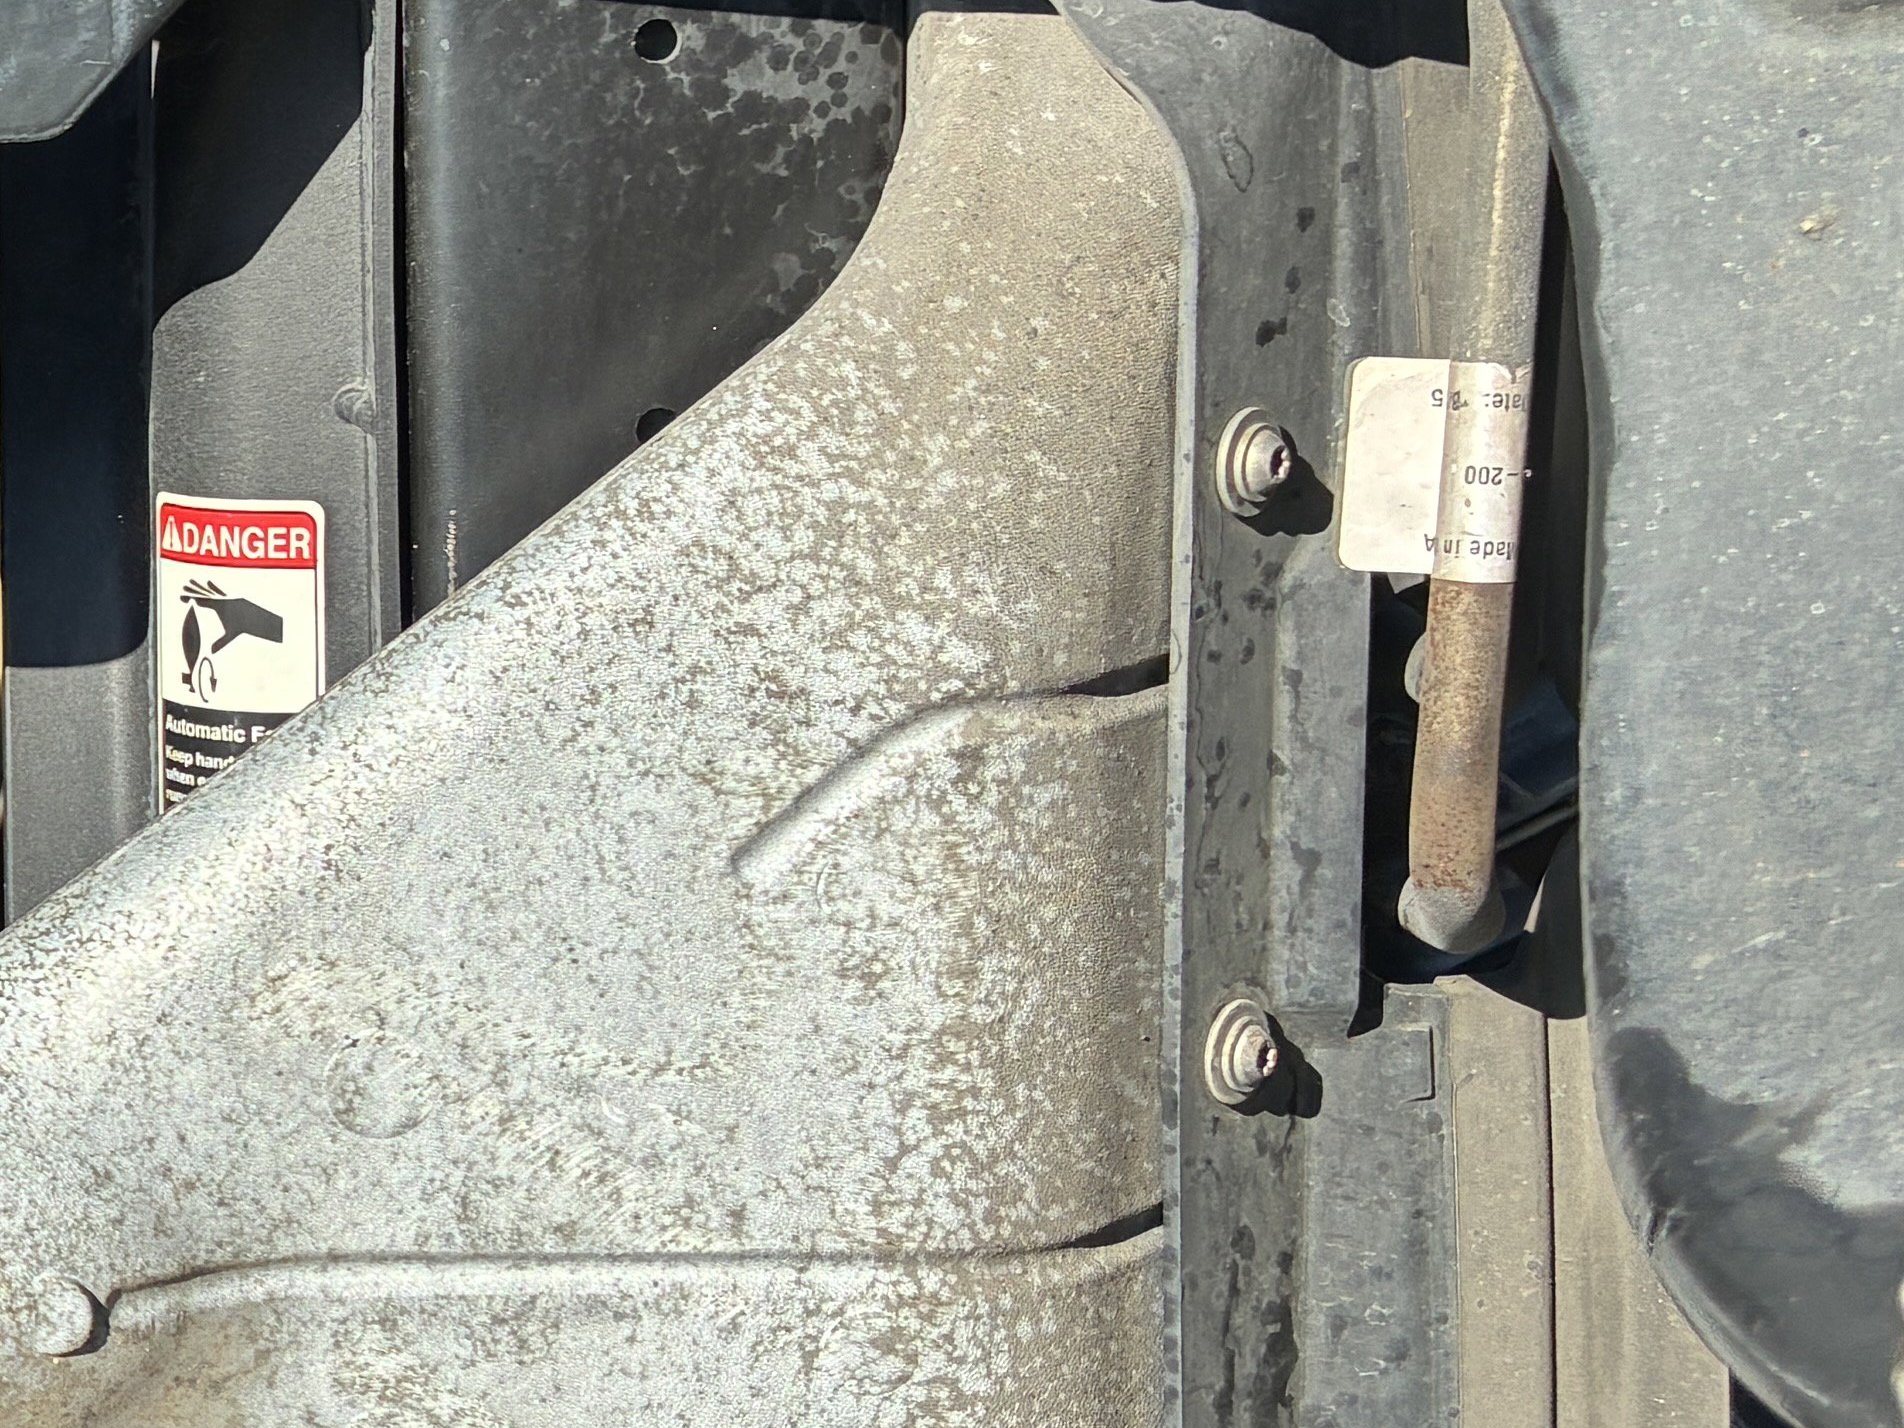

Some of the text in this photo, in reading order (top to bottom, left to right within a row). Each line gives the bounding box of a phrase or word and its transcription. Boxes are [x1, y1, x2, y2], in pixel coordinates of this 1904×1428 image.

[182, 521, 312, 560] DANGER
[1443, 538, 1462, 559] in
[165, 713, 247, 744] Automatic
[165, 744, 194, 768] Keep
